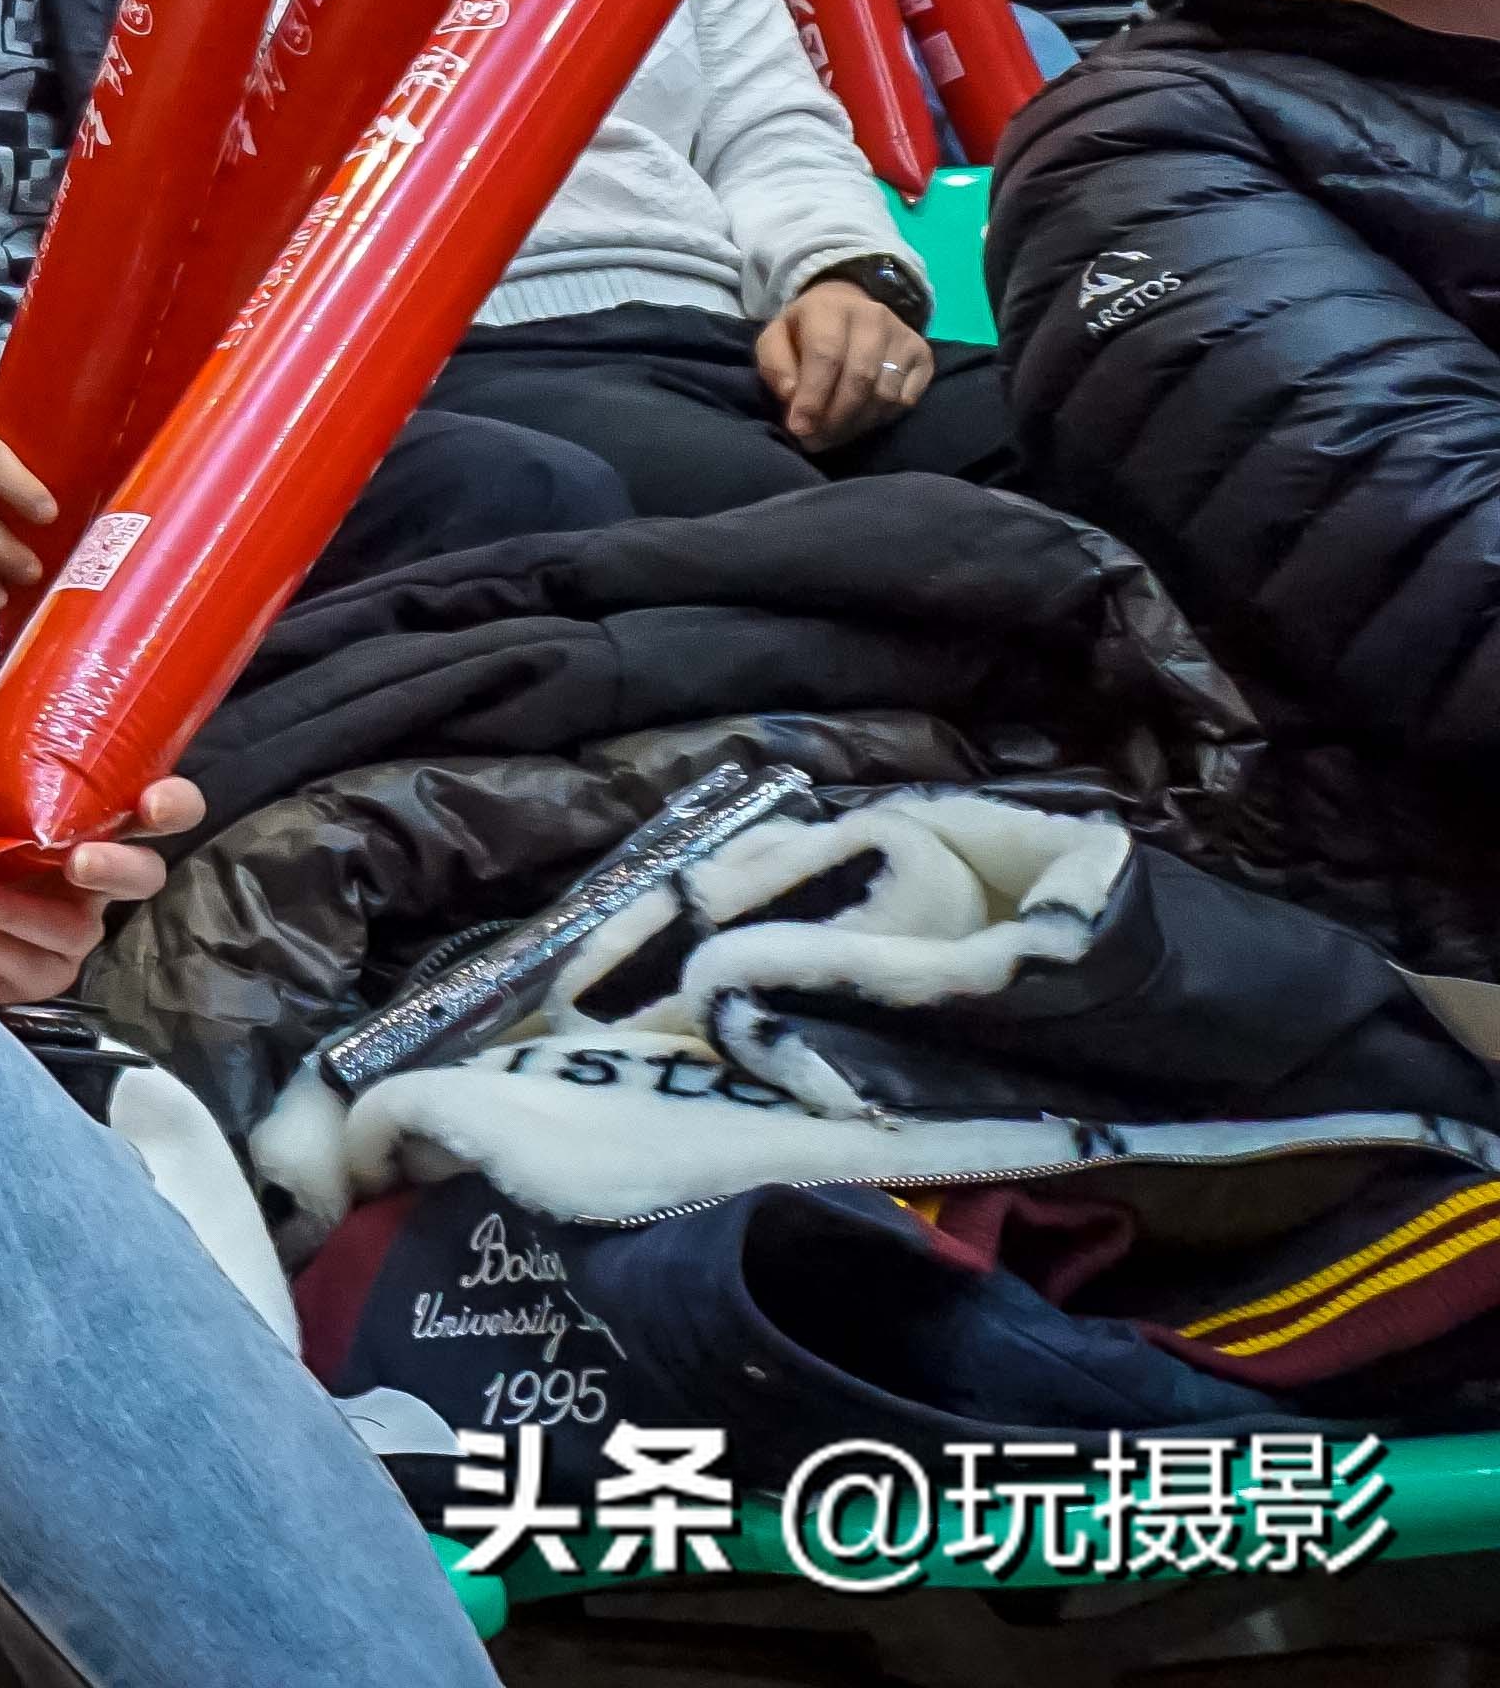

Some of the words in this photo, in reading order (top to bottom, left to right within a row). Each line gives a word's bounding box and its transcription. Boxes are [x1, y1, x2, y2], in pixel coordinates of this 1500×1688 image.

[1085, 269, 1182, 338] ARCTOS
[412, 1290, 568, 1364] University
[483, 1368, 608, 1426] 1995
